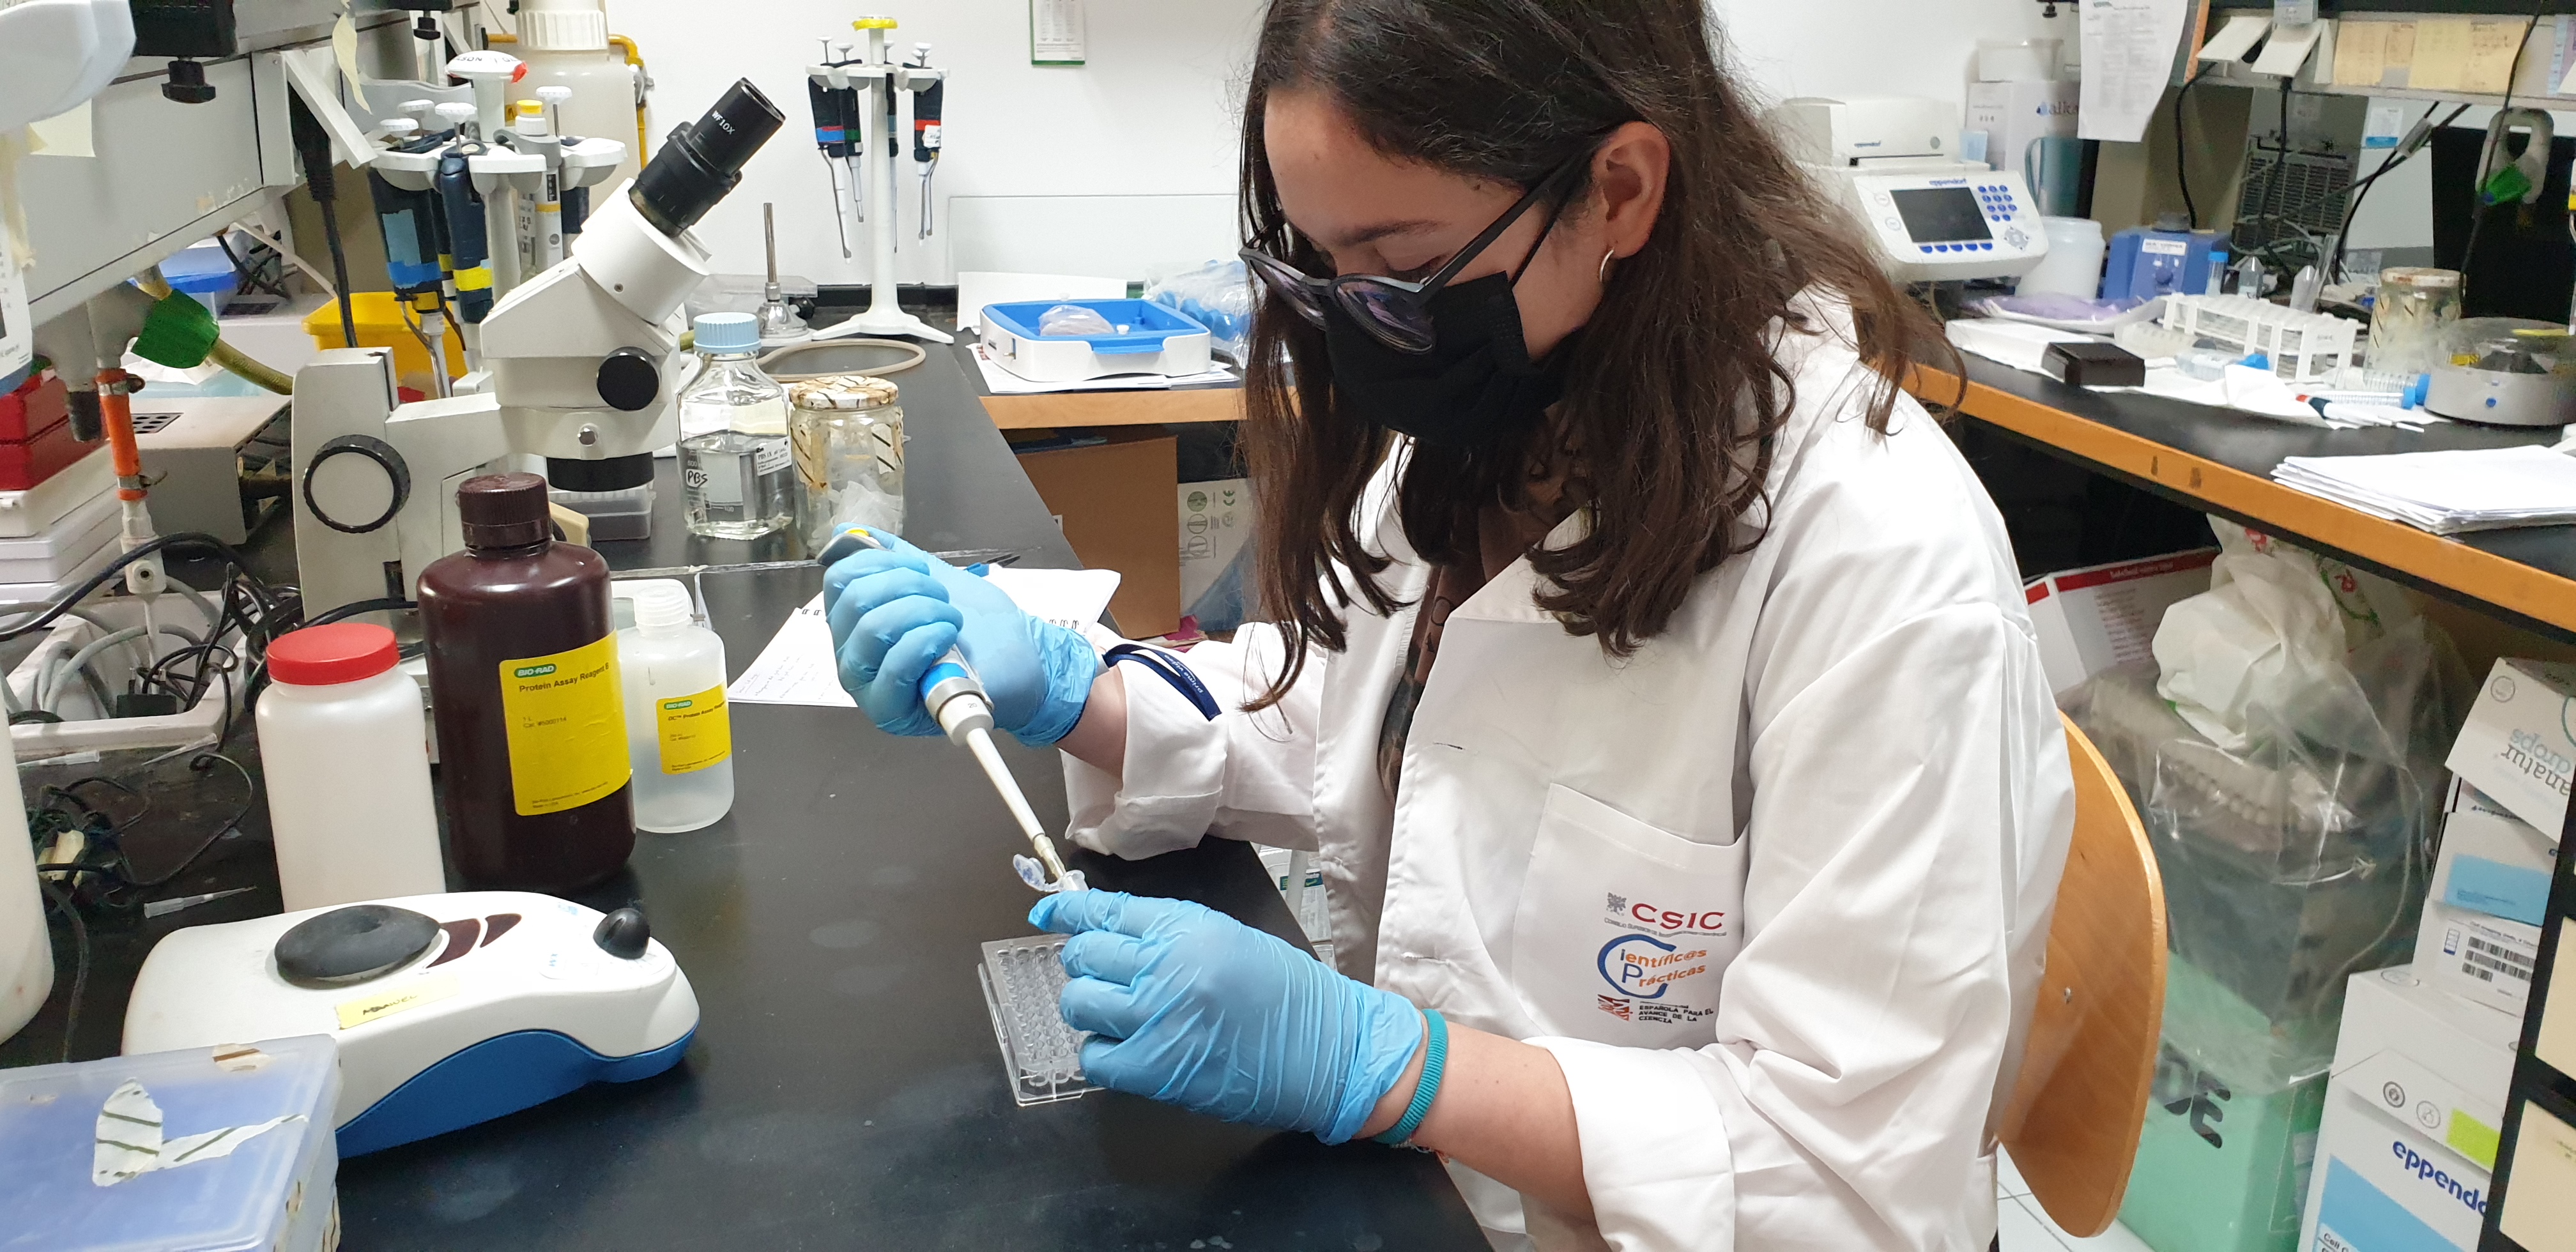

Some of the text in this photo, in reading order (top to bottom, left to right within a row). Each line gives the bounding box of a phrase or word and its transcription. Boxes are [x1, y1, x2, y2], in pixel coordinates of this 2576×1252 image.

[712, 110, 735, 135] WF10X
[687, 470, 708, 485] PBS
[518, 664, 555, 677] BIO-RAD
[519, 682, 551, 692] Protein
[554, 676, 578, 687] Assay
[579, 667, 605, 681] Reagent
[1164, 655, 1204, 693] prime video
[1631, 903, 1726, 930] CSIC
[1639, 1005, 1679, 1013] ESPAÑOLA
[1638, 1016, 1673, 1024] CIENCIA
